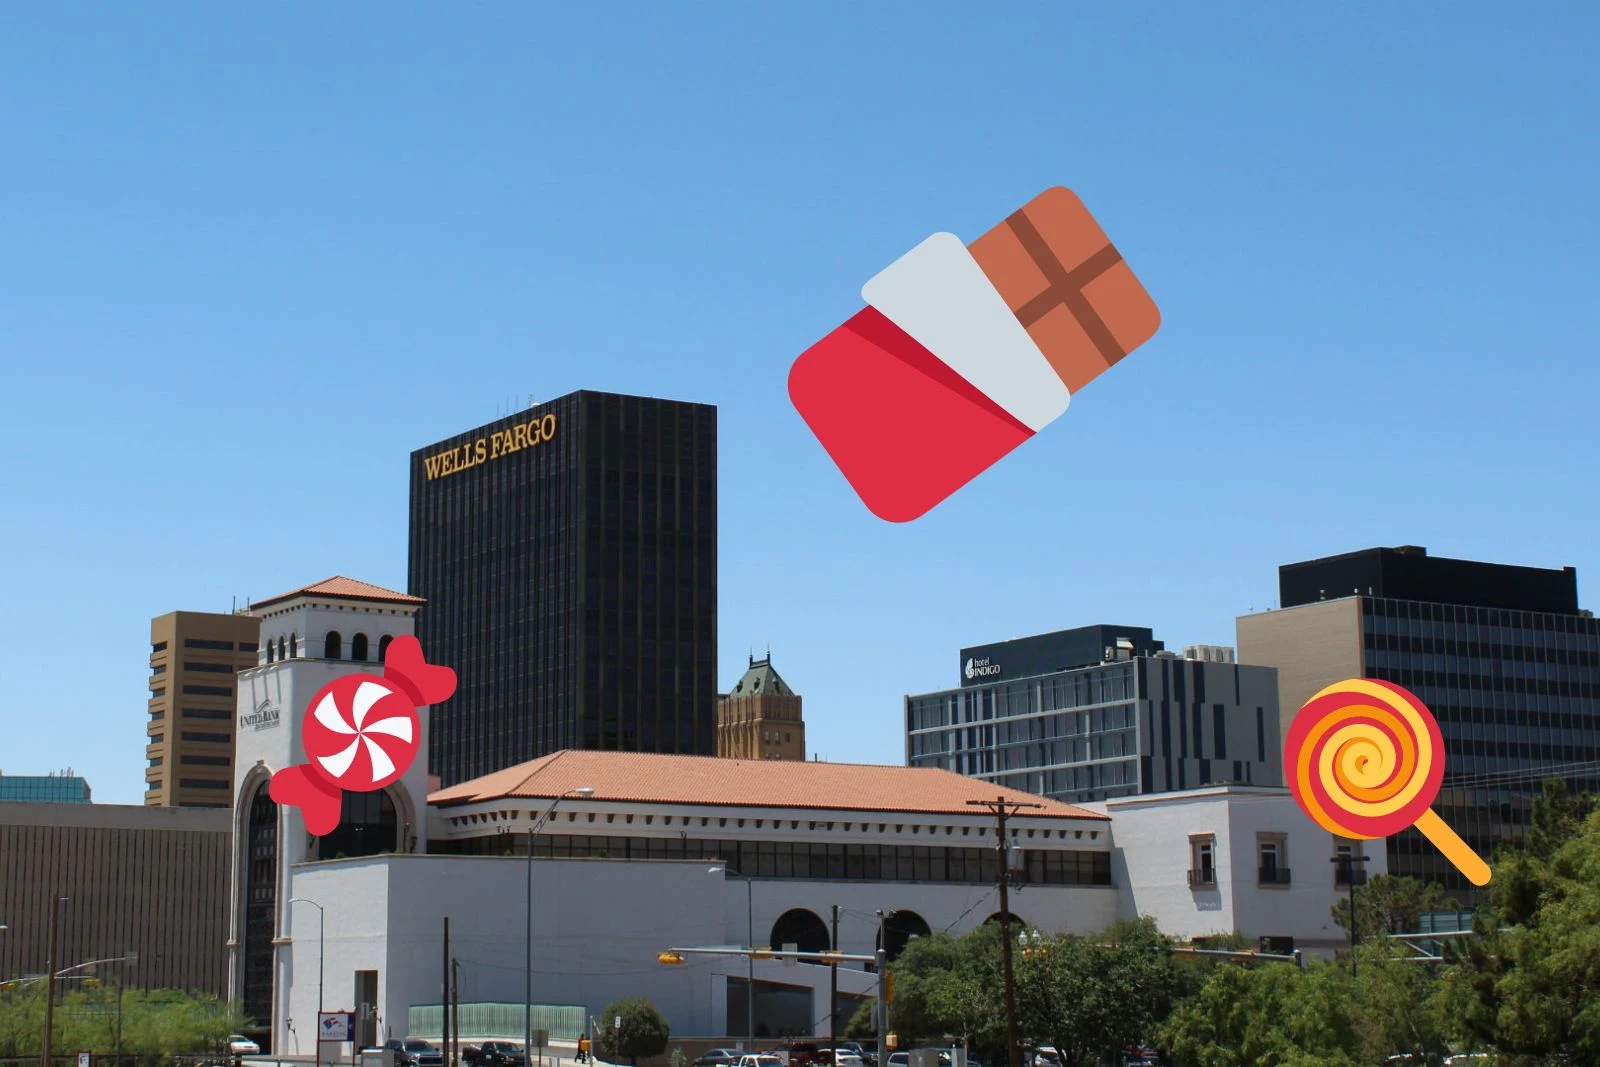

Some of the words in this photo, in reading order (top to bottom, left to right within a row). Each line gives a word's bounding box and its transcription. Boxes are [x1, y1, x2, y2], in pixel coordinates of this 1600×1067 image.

[424, 438, 487, 480] WELLS
[490, 414, 556, 459] FARGO
[974, 657, 990, 667] hotel
[974, 664, 1001, 677] INDIGO
